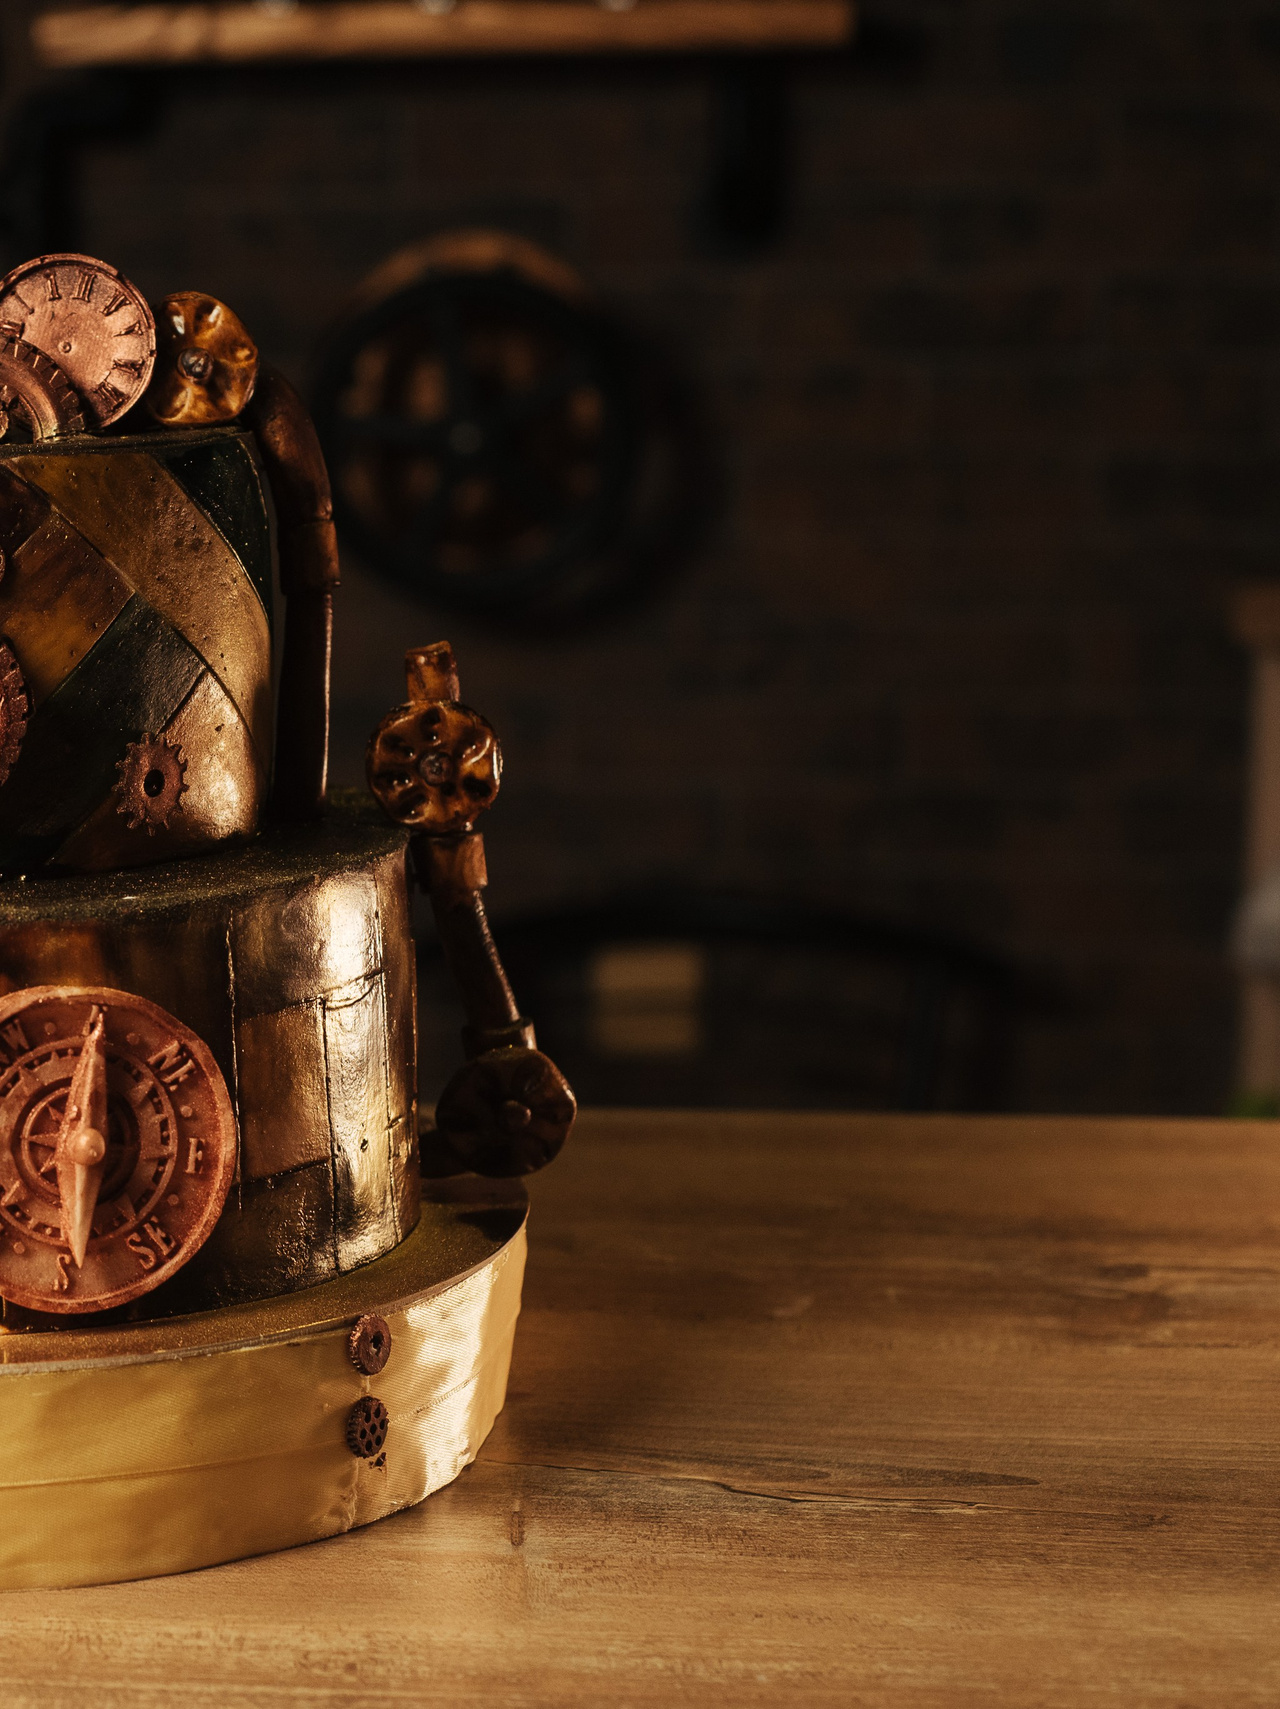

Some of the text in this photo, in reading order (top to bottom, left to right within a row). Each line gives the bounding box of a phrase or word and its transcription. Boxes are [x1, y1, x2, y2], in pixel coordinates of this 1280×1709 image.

[70, 268, 98, 303] III
[147, 1040, 197, 1092] NE
[185, 1137, 206, 1174] E
[125, 1215, 176, 1270] SE
[53, 1253, 70, 1291] S
